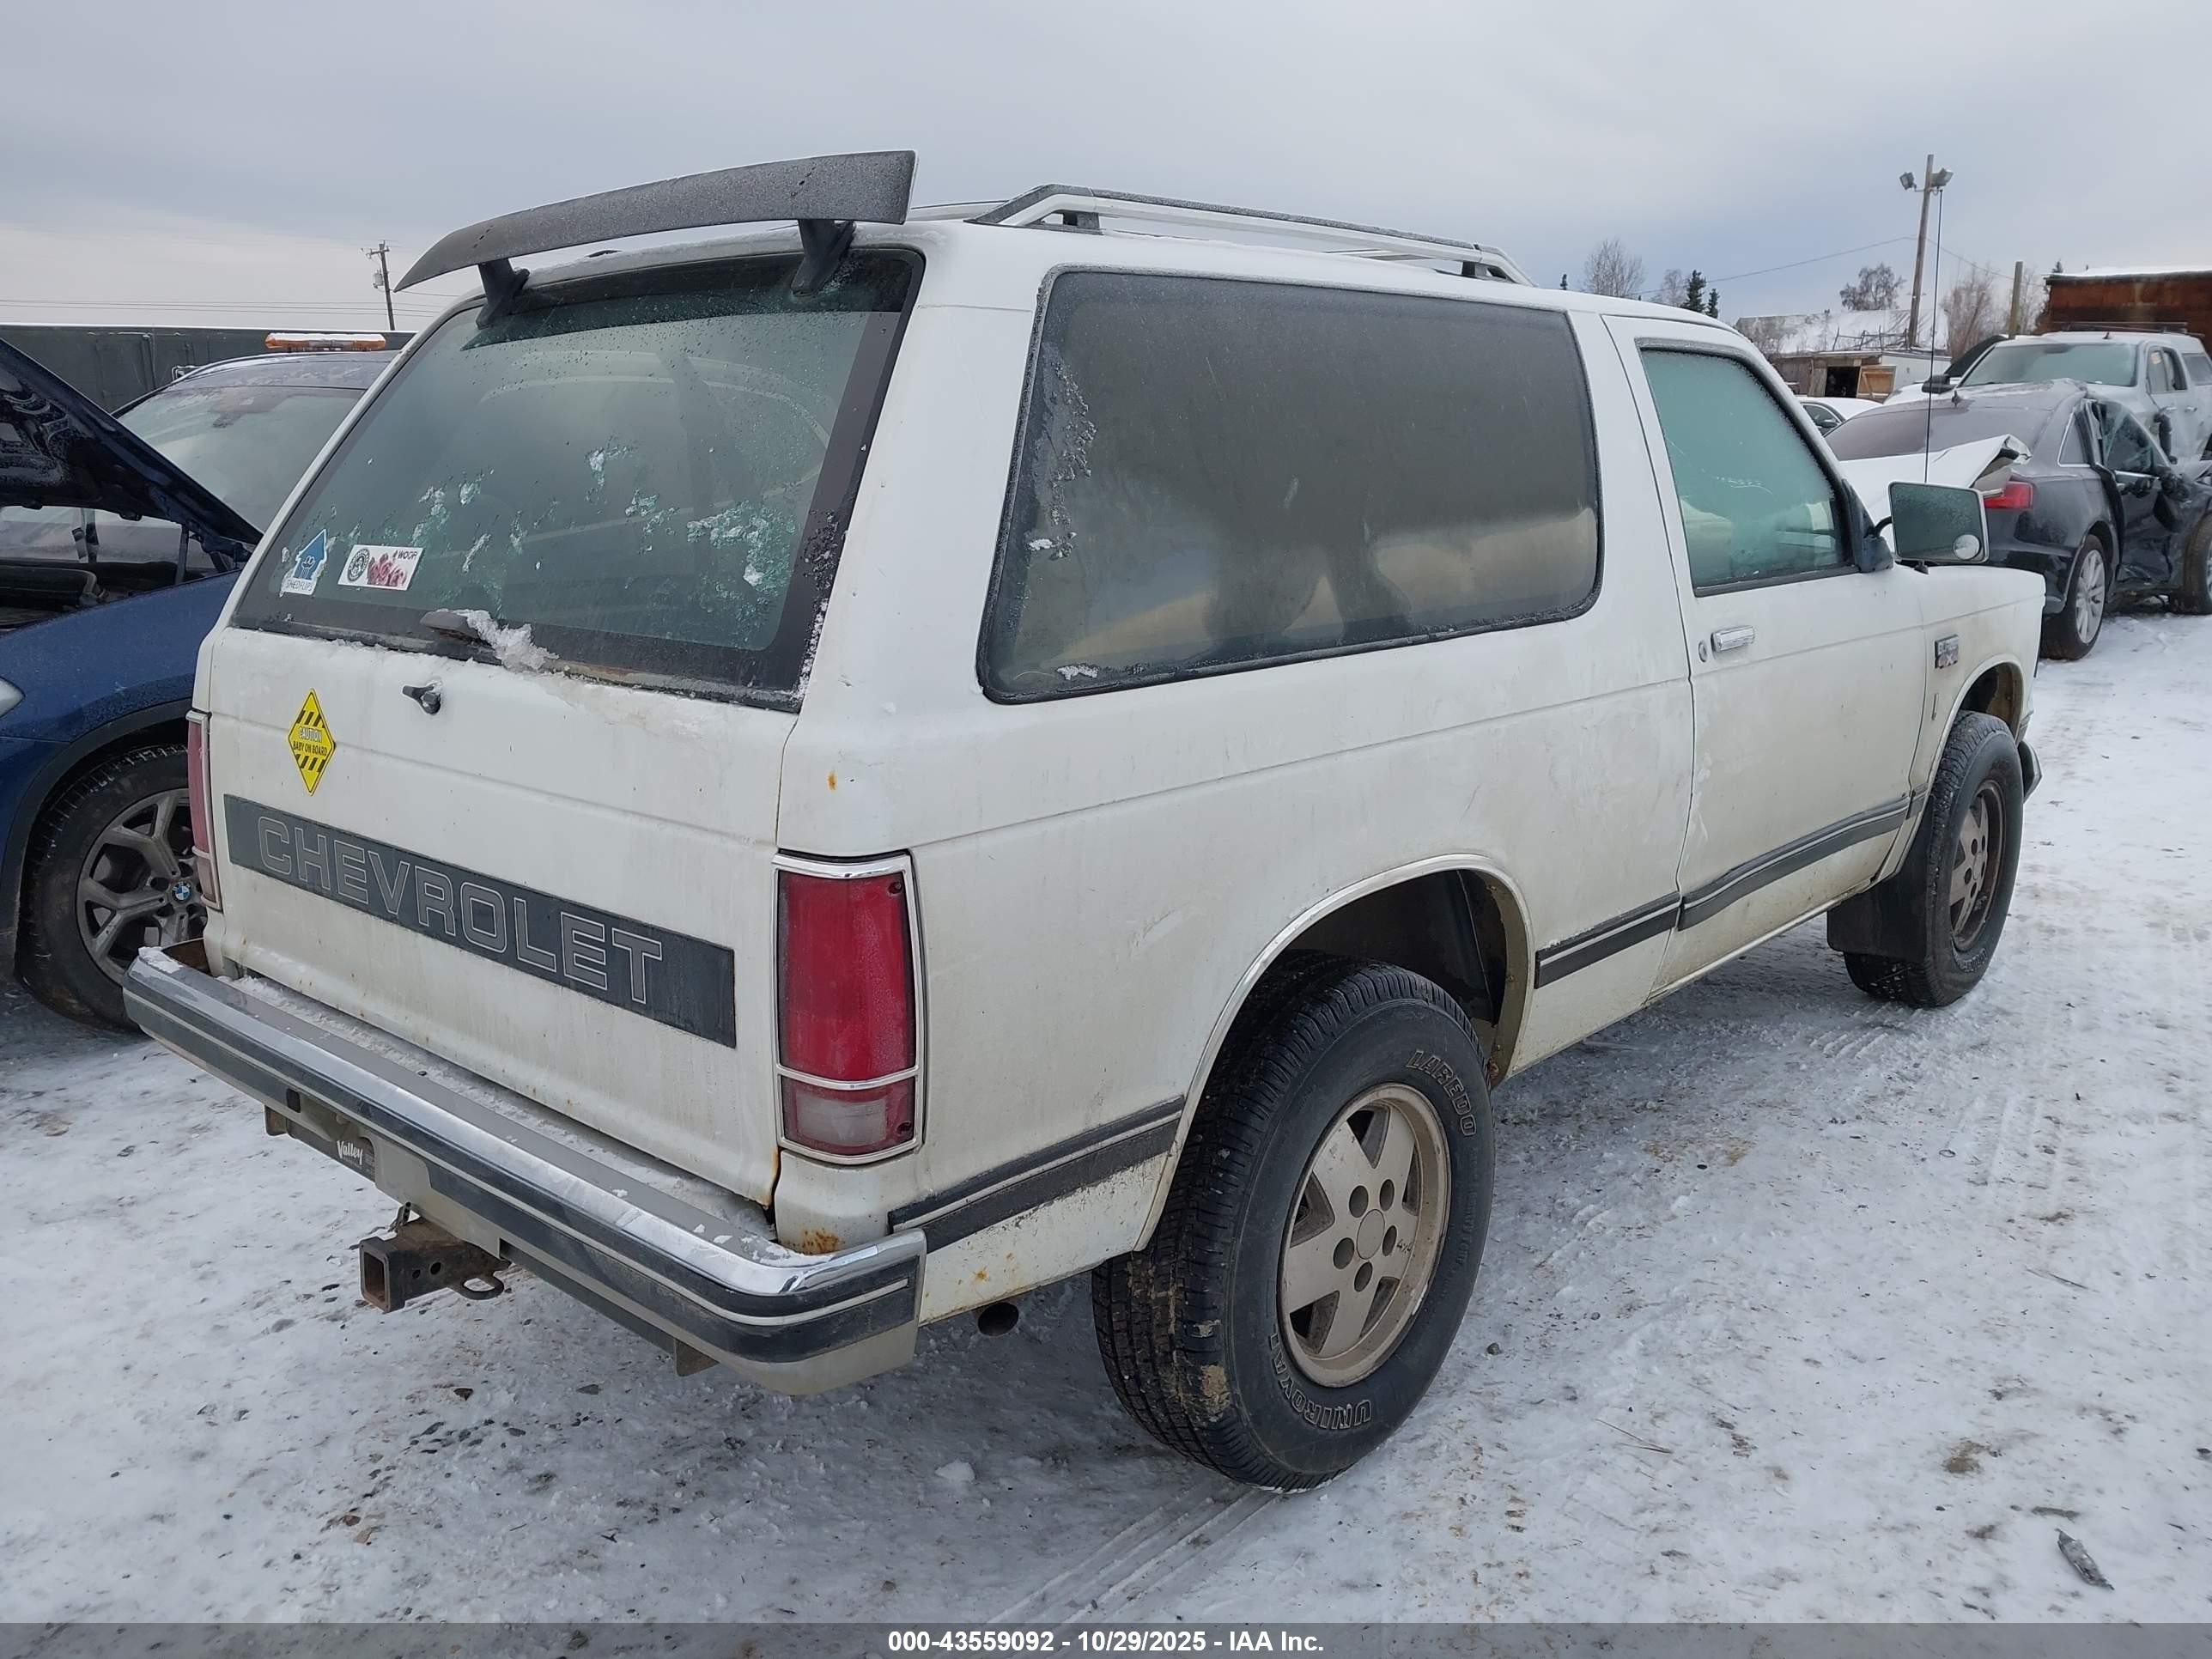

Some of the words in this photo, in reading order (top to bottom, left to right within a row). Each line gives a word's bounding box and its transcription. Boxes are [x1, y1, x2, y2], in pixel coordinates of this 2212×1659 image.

[293, 742, 304, 751] BABY
[304, 743, 311, 753] ON
[312, 745, 327, 755] BOARD
[299, 727, 321, 742] CAUTION
[258, 816, 662, 1005] CHEVROLET
[1406, 1050, 1477, 1137] LAREDO
[337, 1139, 363, 1165] Valley
[1270, 1323, 1372, 1430] UNIROYAL
